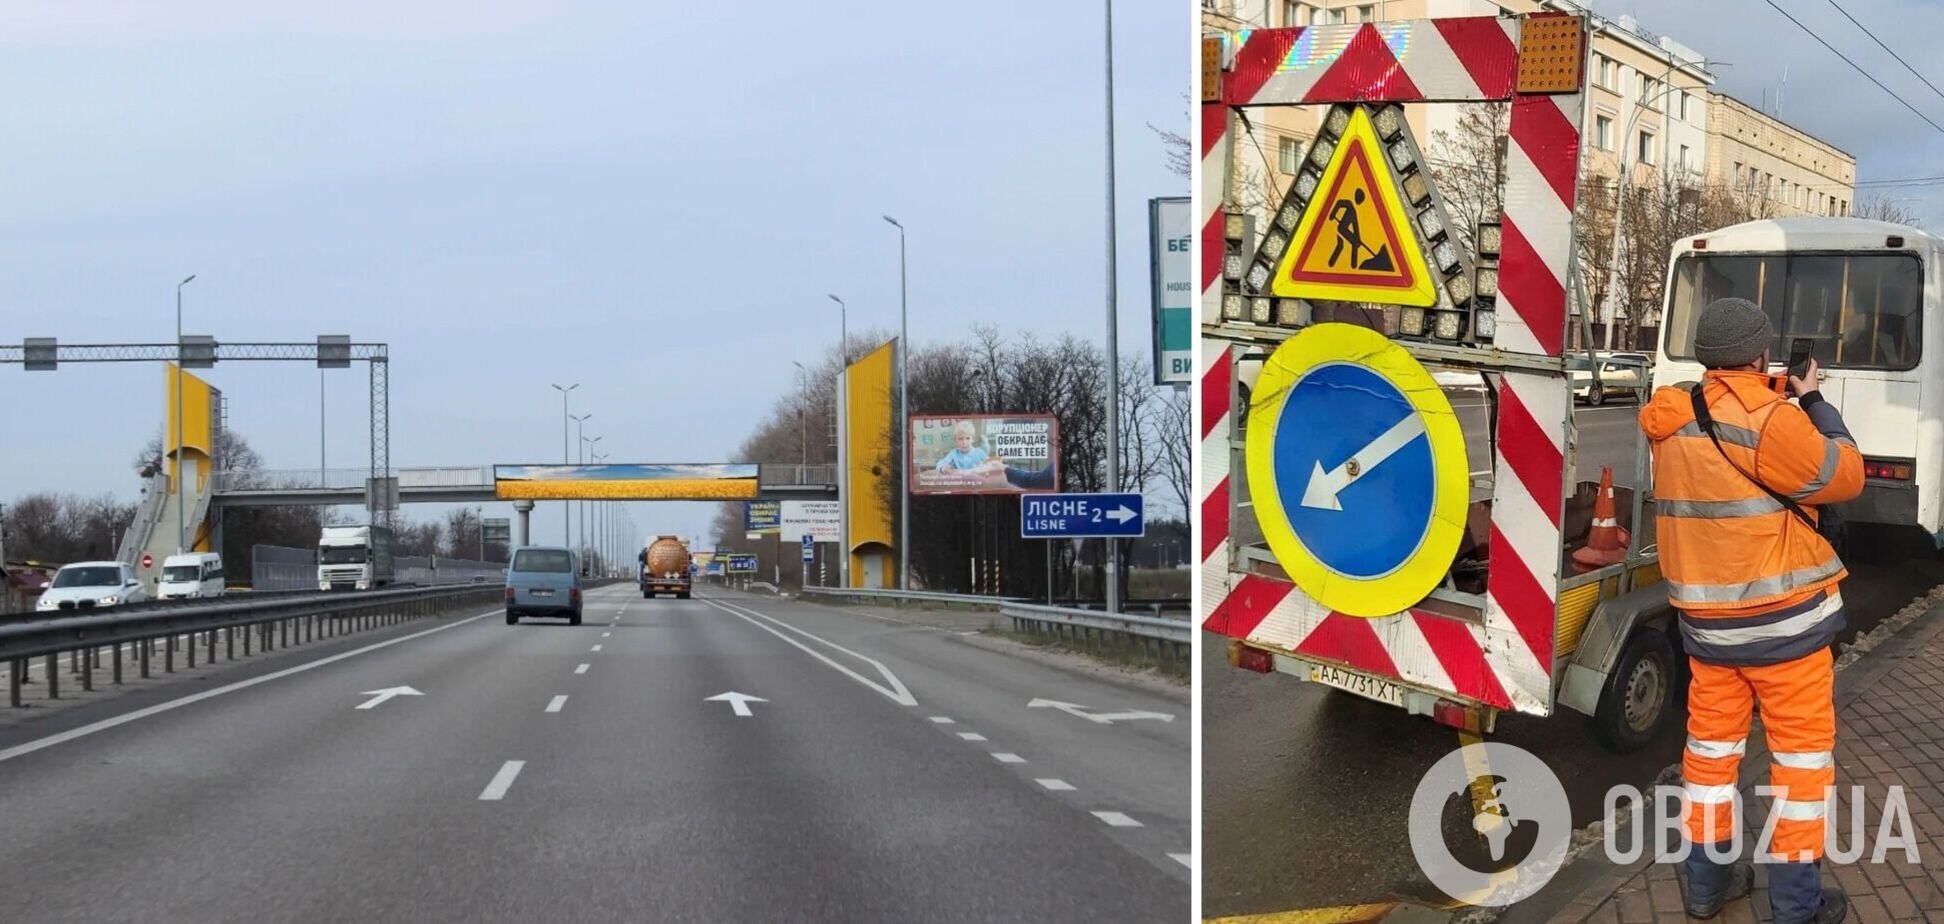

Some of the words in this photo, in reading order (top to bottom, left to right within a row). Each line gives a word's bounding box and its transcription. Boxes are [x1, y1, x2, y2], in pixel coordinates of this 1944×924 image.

[998, 435, 1046, 446] ОБКРАДАЄ
[998, 447, 1022, 457] САМЕ
[1024, 447, 1046, 457] ТЕБЕ
[1027, 500, 1088, 516] ЛІСНЕ
[1091, 507, 1102, 522] 2
[1027, 519, 1067, 530] LISNE
